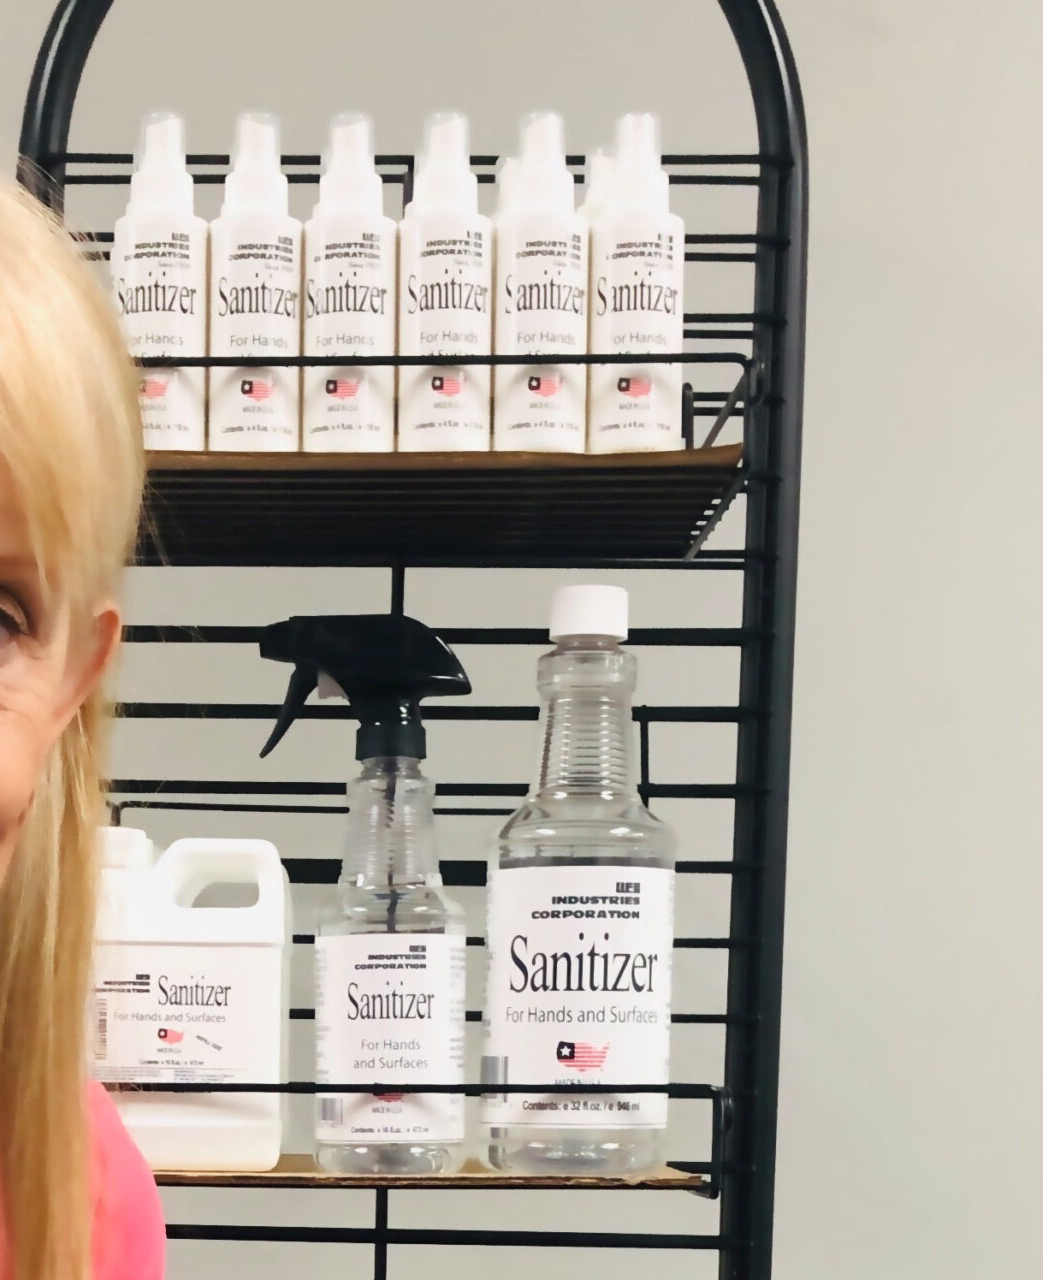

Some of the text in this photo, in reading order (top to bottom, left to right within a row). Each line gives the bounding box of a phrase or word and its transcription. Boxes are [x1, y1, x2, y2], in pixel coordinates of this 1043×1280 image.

[134, 242, 190, 250] NDUSTRIES
[325, 242, 381, 250] NDUSTRIES
[426, 239, 482, 249] INDUSTRES
[525, 240, 581, 251] INDUSTES
[616, 242, 673, 251] INDUSTRS
[420, 248, 482, 257] ORPORATON
[516, 249, 581, 260] CORPORATON
[606, 250, 673, 261] ORPORATN
[118, 271, 197, 316] Sanitizer
[218, 273, 298, 319] Sanitizer
[306, 271, 387, 319] Sanitizer
[408, 269, 488, 315] Sanitizer
[506, 270, 585, 316] Sanitizer
[230, 335, 247, 347] For
[316, 335, 332, 347] For
[420, 331, 437, 344] For
[517, 330, 575, 345] For Hands
[629, 330, 667, 345] Hands
[551, 896, 640, 905] INDUSTRIES
[531, 910, 640, 919] CORPORATION
[509, 932, 658, 993] Sanitizer
[158, 975, 231, 1007] Sanitizer
[347, 981, 435, 1020] Sanitizer
[132, 1012, 162, 1021] Hands
[164, 1012, 184, 1022] and
[186, 1012, 226, 1023] Surfaces
[506, 1005, 658, 1023] For Hands and Surfaces
[361, 1039, 421, 1050] For Hands
[353, 1057, 428, 1069] and Surfaces
[571, 1101, 580, 1111] 32
